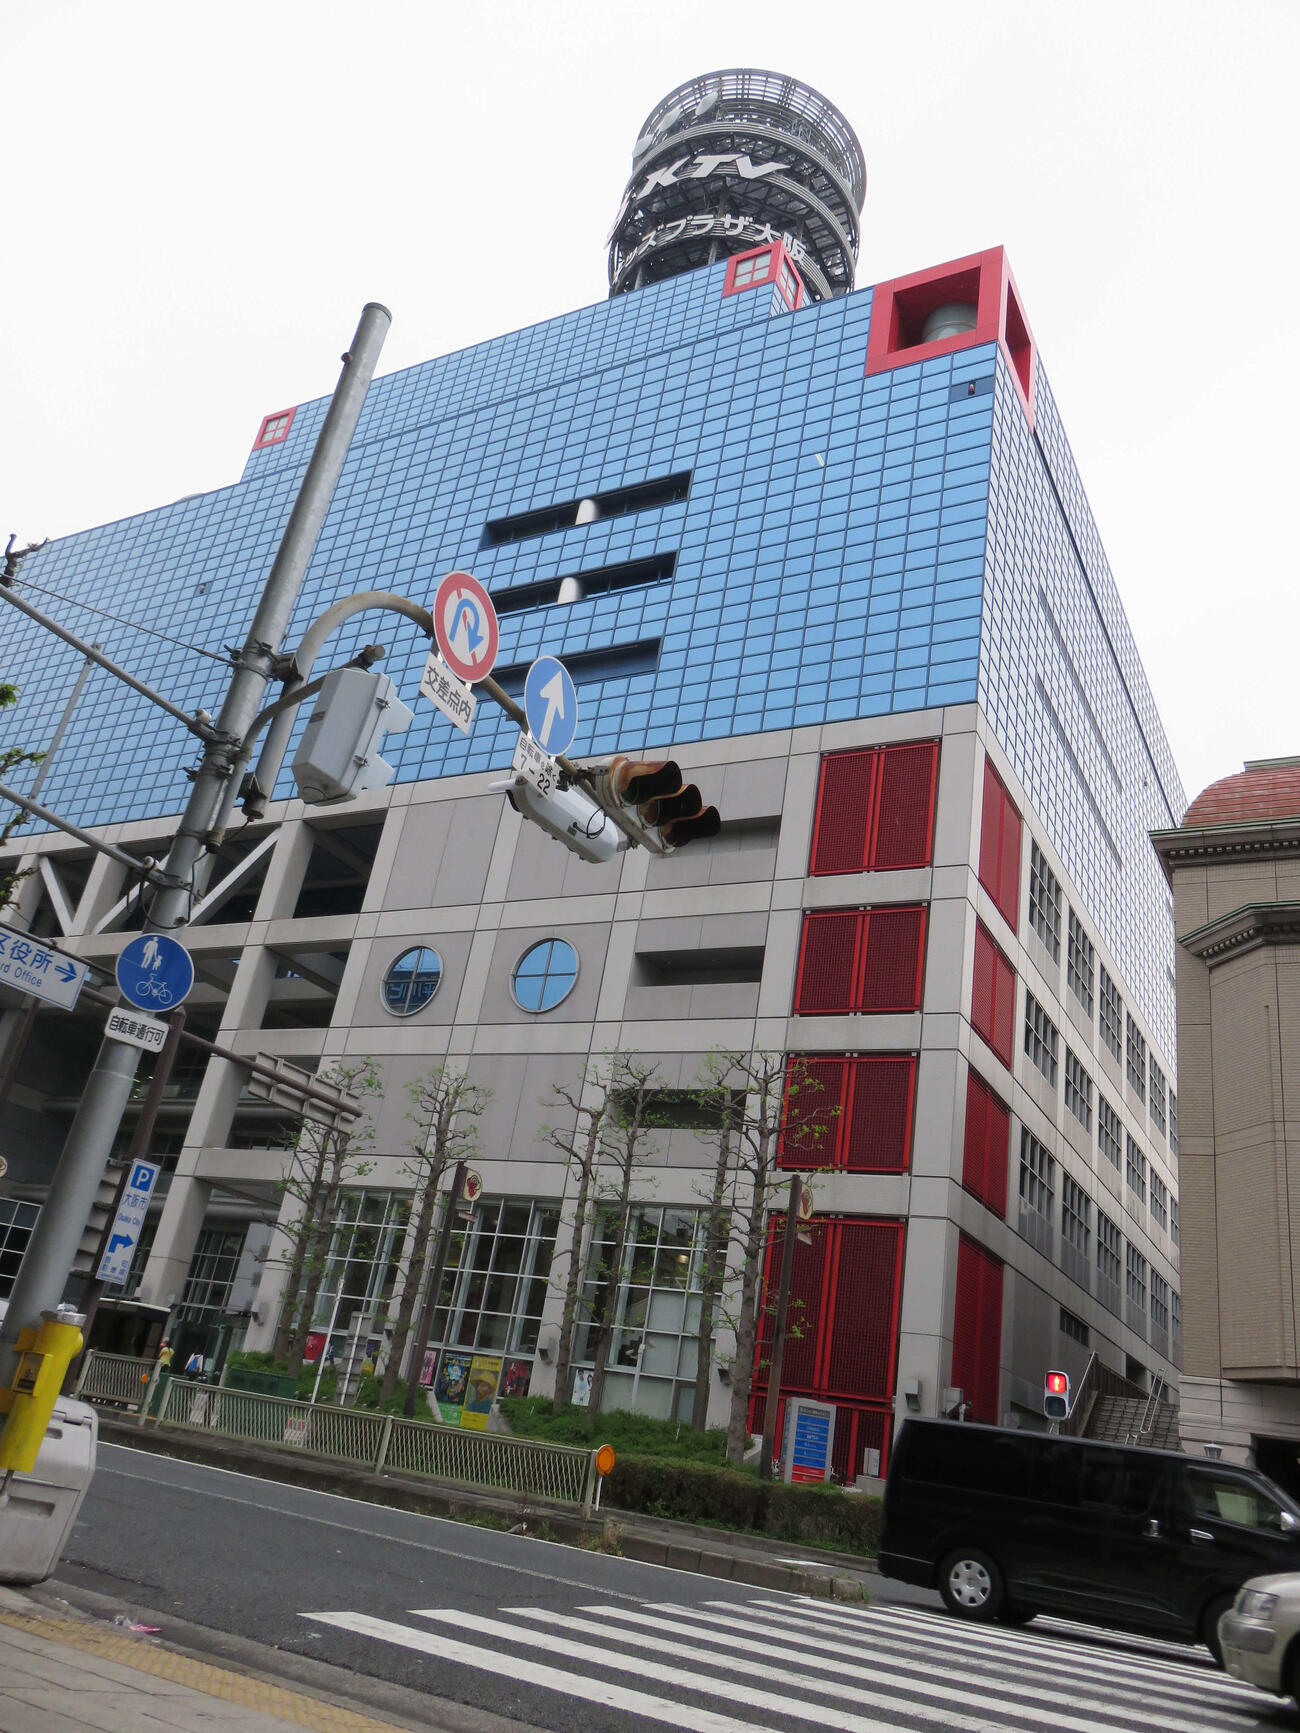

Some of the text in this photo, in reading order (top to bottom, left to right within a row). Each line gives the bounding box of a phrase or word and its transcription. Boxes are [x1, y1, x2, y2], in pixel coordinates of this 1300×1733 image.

[637, 154, 791, 200] KTV
[424, 664, 472, 725] 交差点内
[14, 966, 43, 987] Office
[109, 1015, 165, 1046] 自転車通行可
[136, 1168, 150, 1187] P
[122, 1192, 148, 1210] 大阪市
